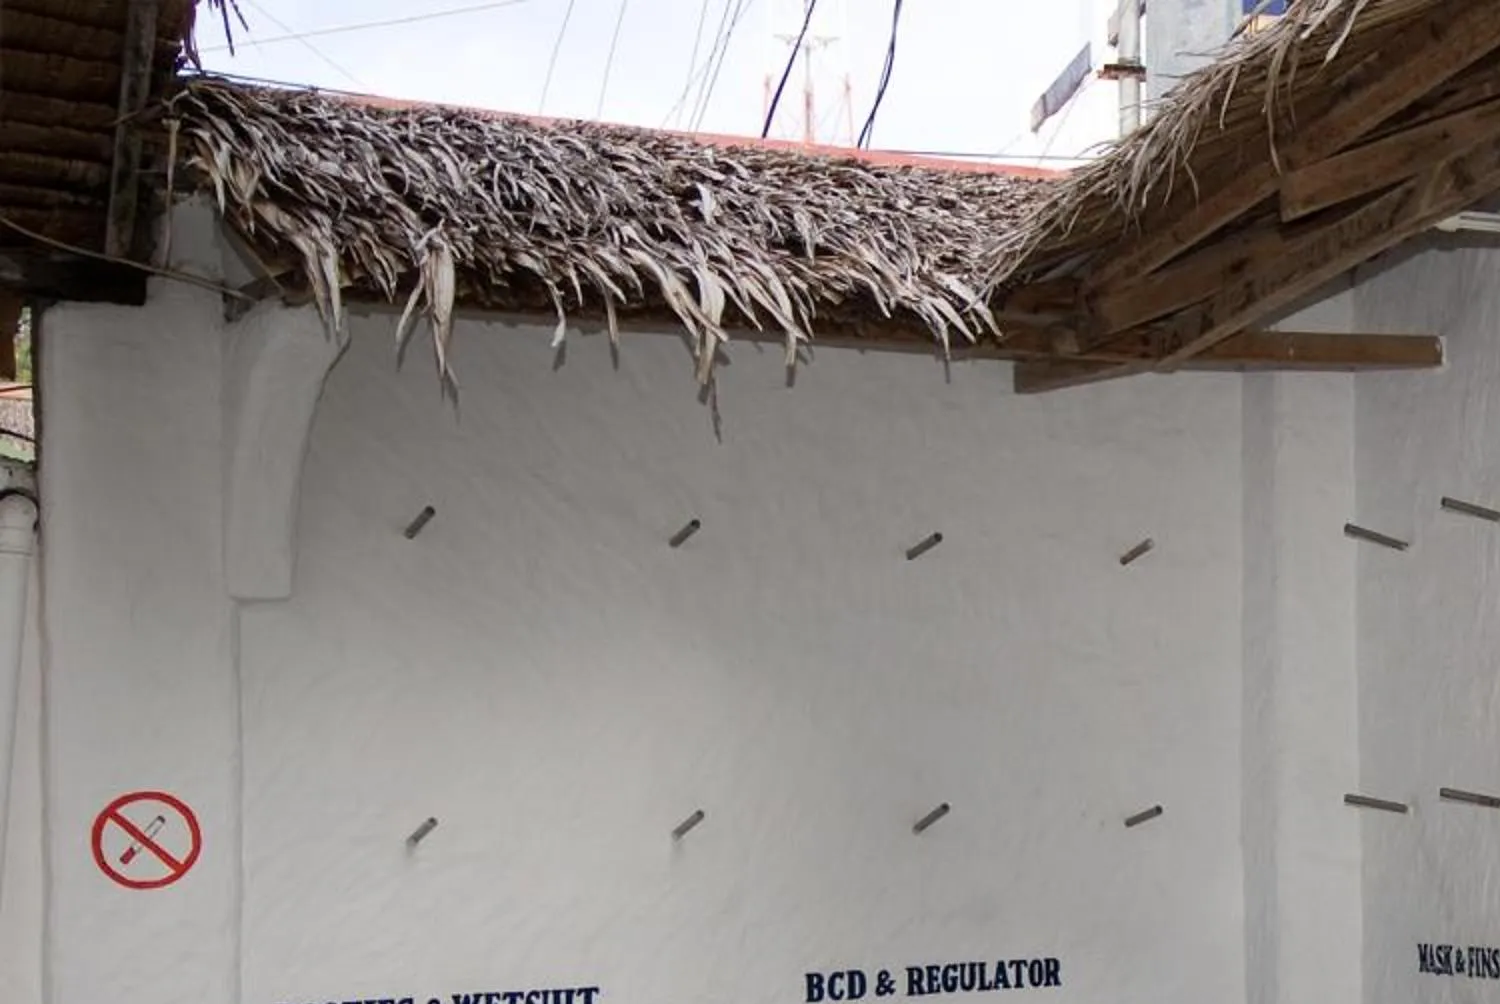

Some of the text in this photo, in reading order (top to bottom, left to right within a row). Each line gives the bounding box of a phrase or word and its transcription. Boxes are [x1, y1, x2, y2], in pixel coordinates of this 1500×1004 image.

[805, 957, 1062, 1003] BCD & REGULATOR
[1417, 943, 1500, 979] MASK & FINS
